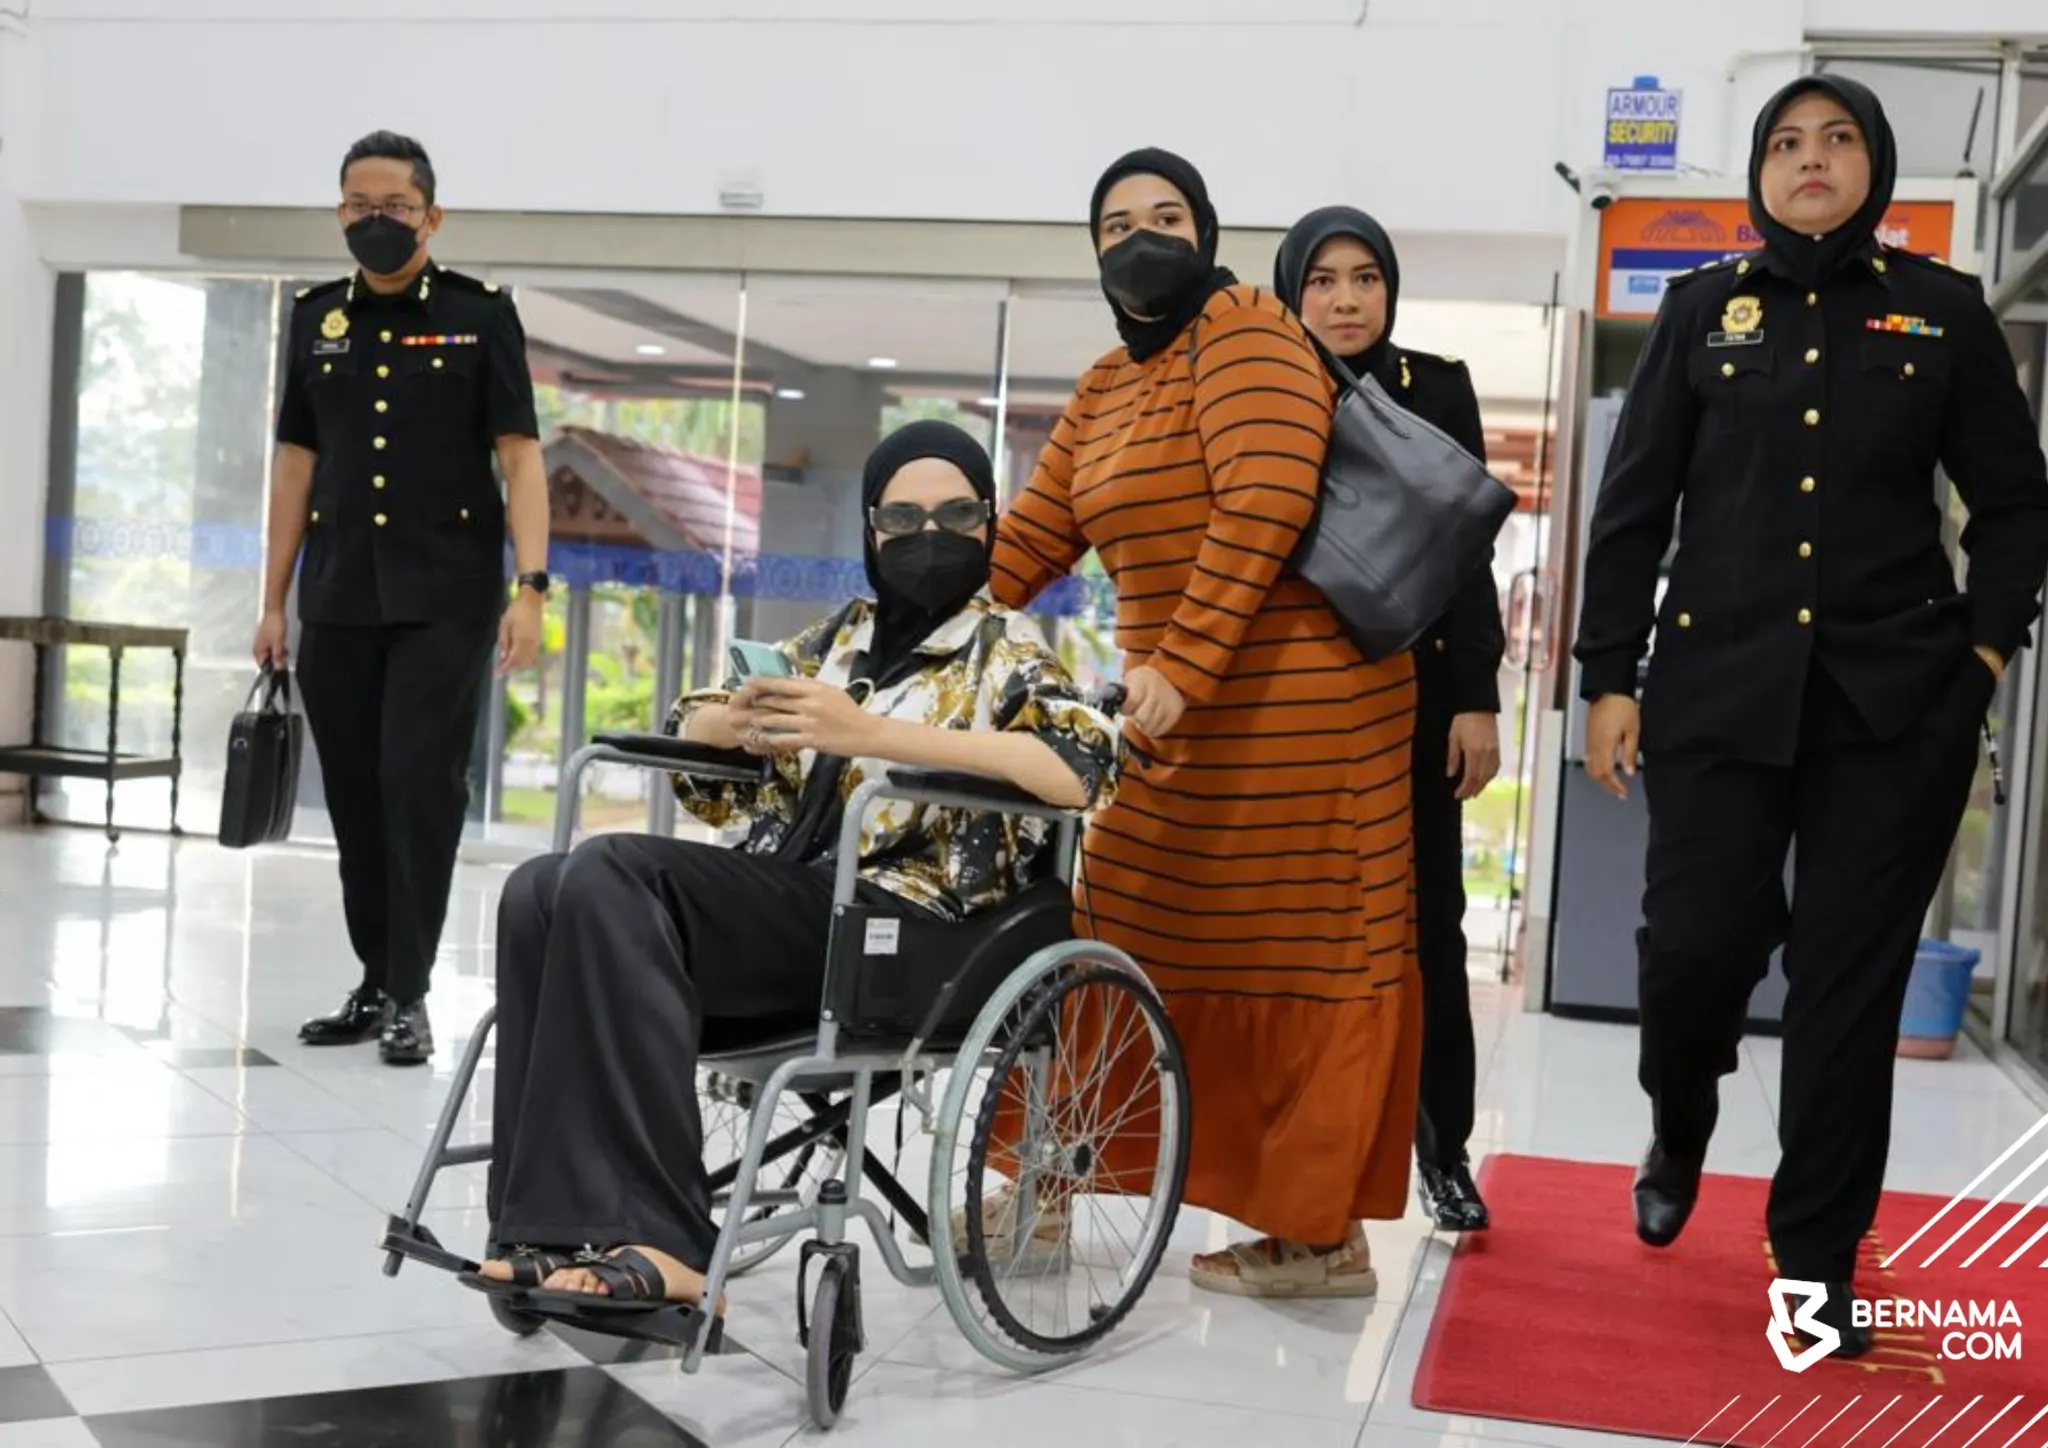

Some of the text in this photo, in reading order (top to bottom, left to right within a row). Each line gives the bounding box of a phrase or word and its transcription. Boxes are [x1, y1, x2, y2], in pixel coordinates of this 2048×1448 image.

[1612, 94, 1678, 116] ARMOUR
[1609, 121, 1675, 144] SECURITY
[1737, 224, 1761, 242] Ba
